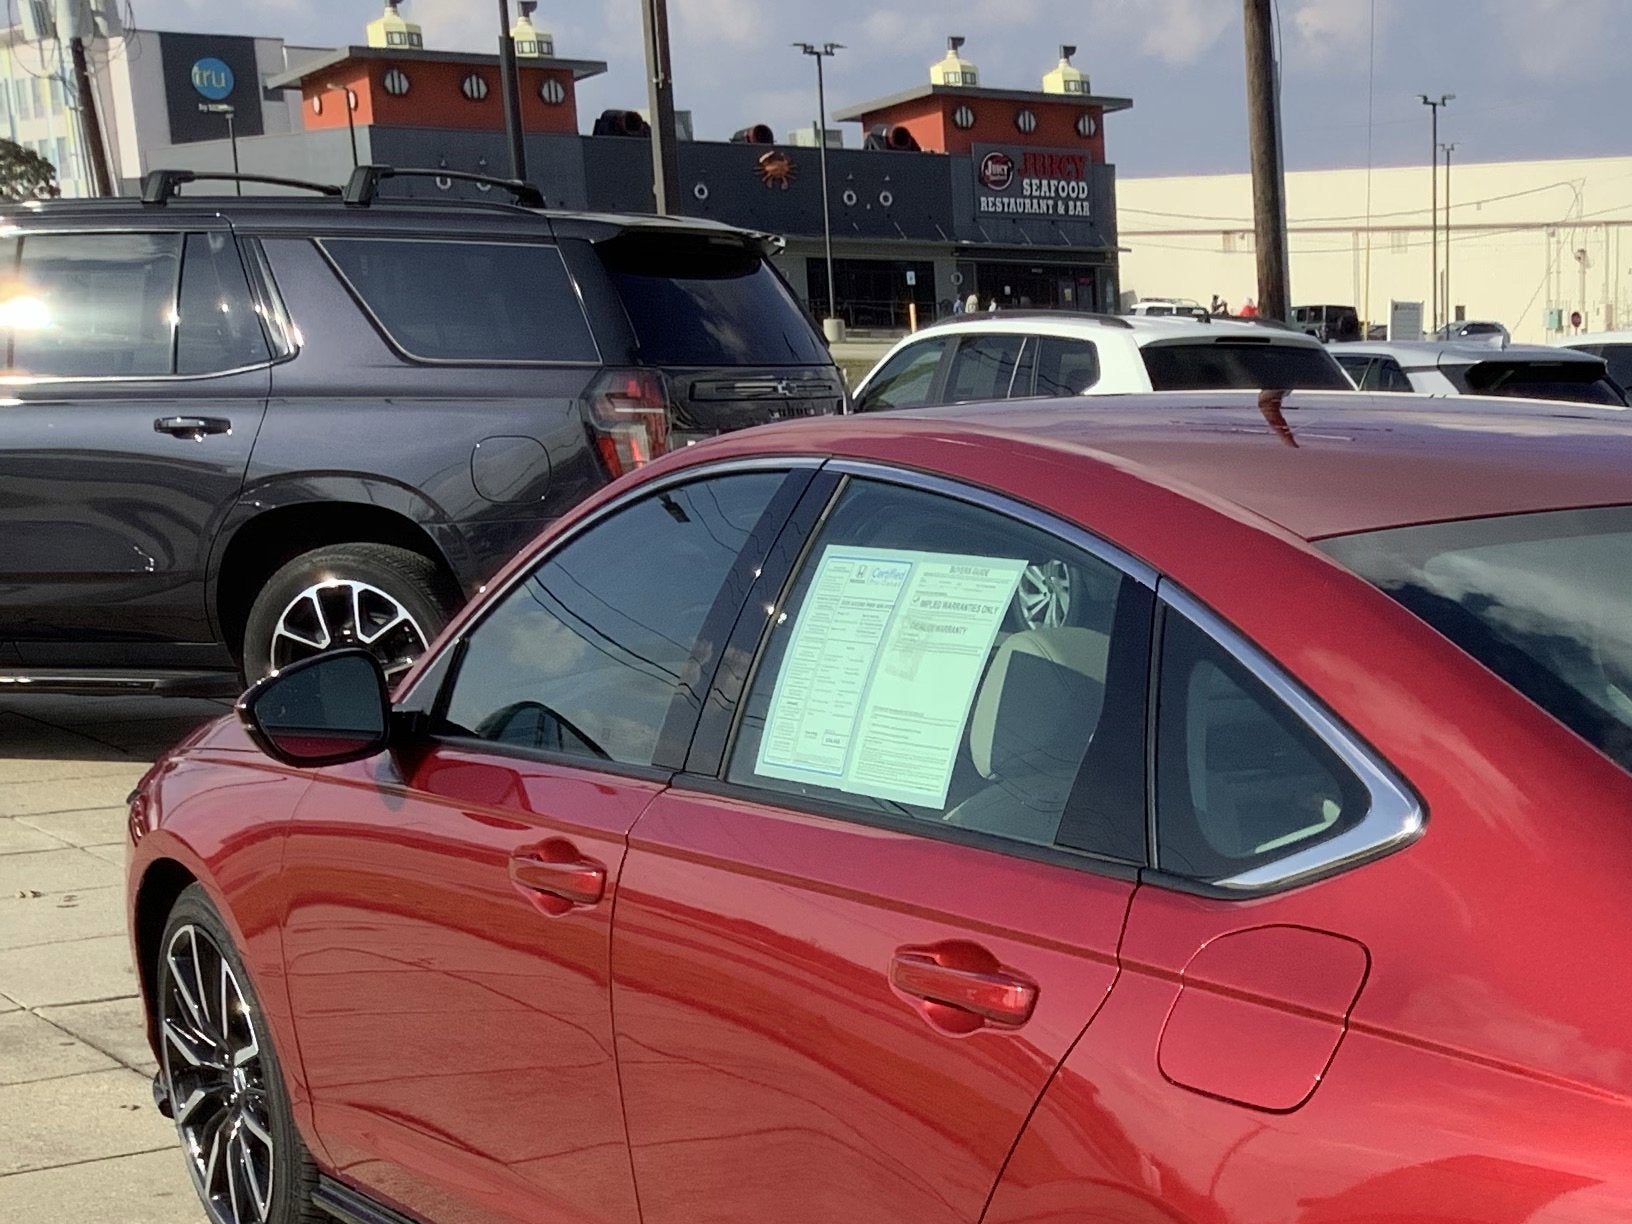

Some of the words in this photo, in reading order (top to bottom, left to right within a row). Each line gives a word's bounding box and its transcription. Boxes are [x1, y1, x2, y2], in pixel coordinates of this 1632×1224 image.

[192, 65, 226, 88] tru
[1022, 179, 1088, 199] SEAFOOD
[980, 197, 1054, 214] RESTAURANT
[1057, 201, 1065, 215] &
[1068, 201, 1090, 216] BAR
